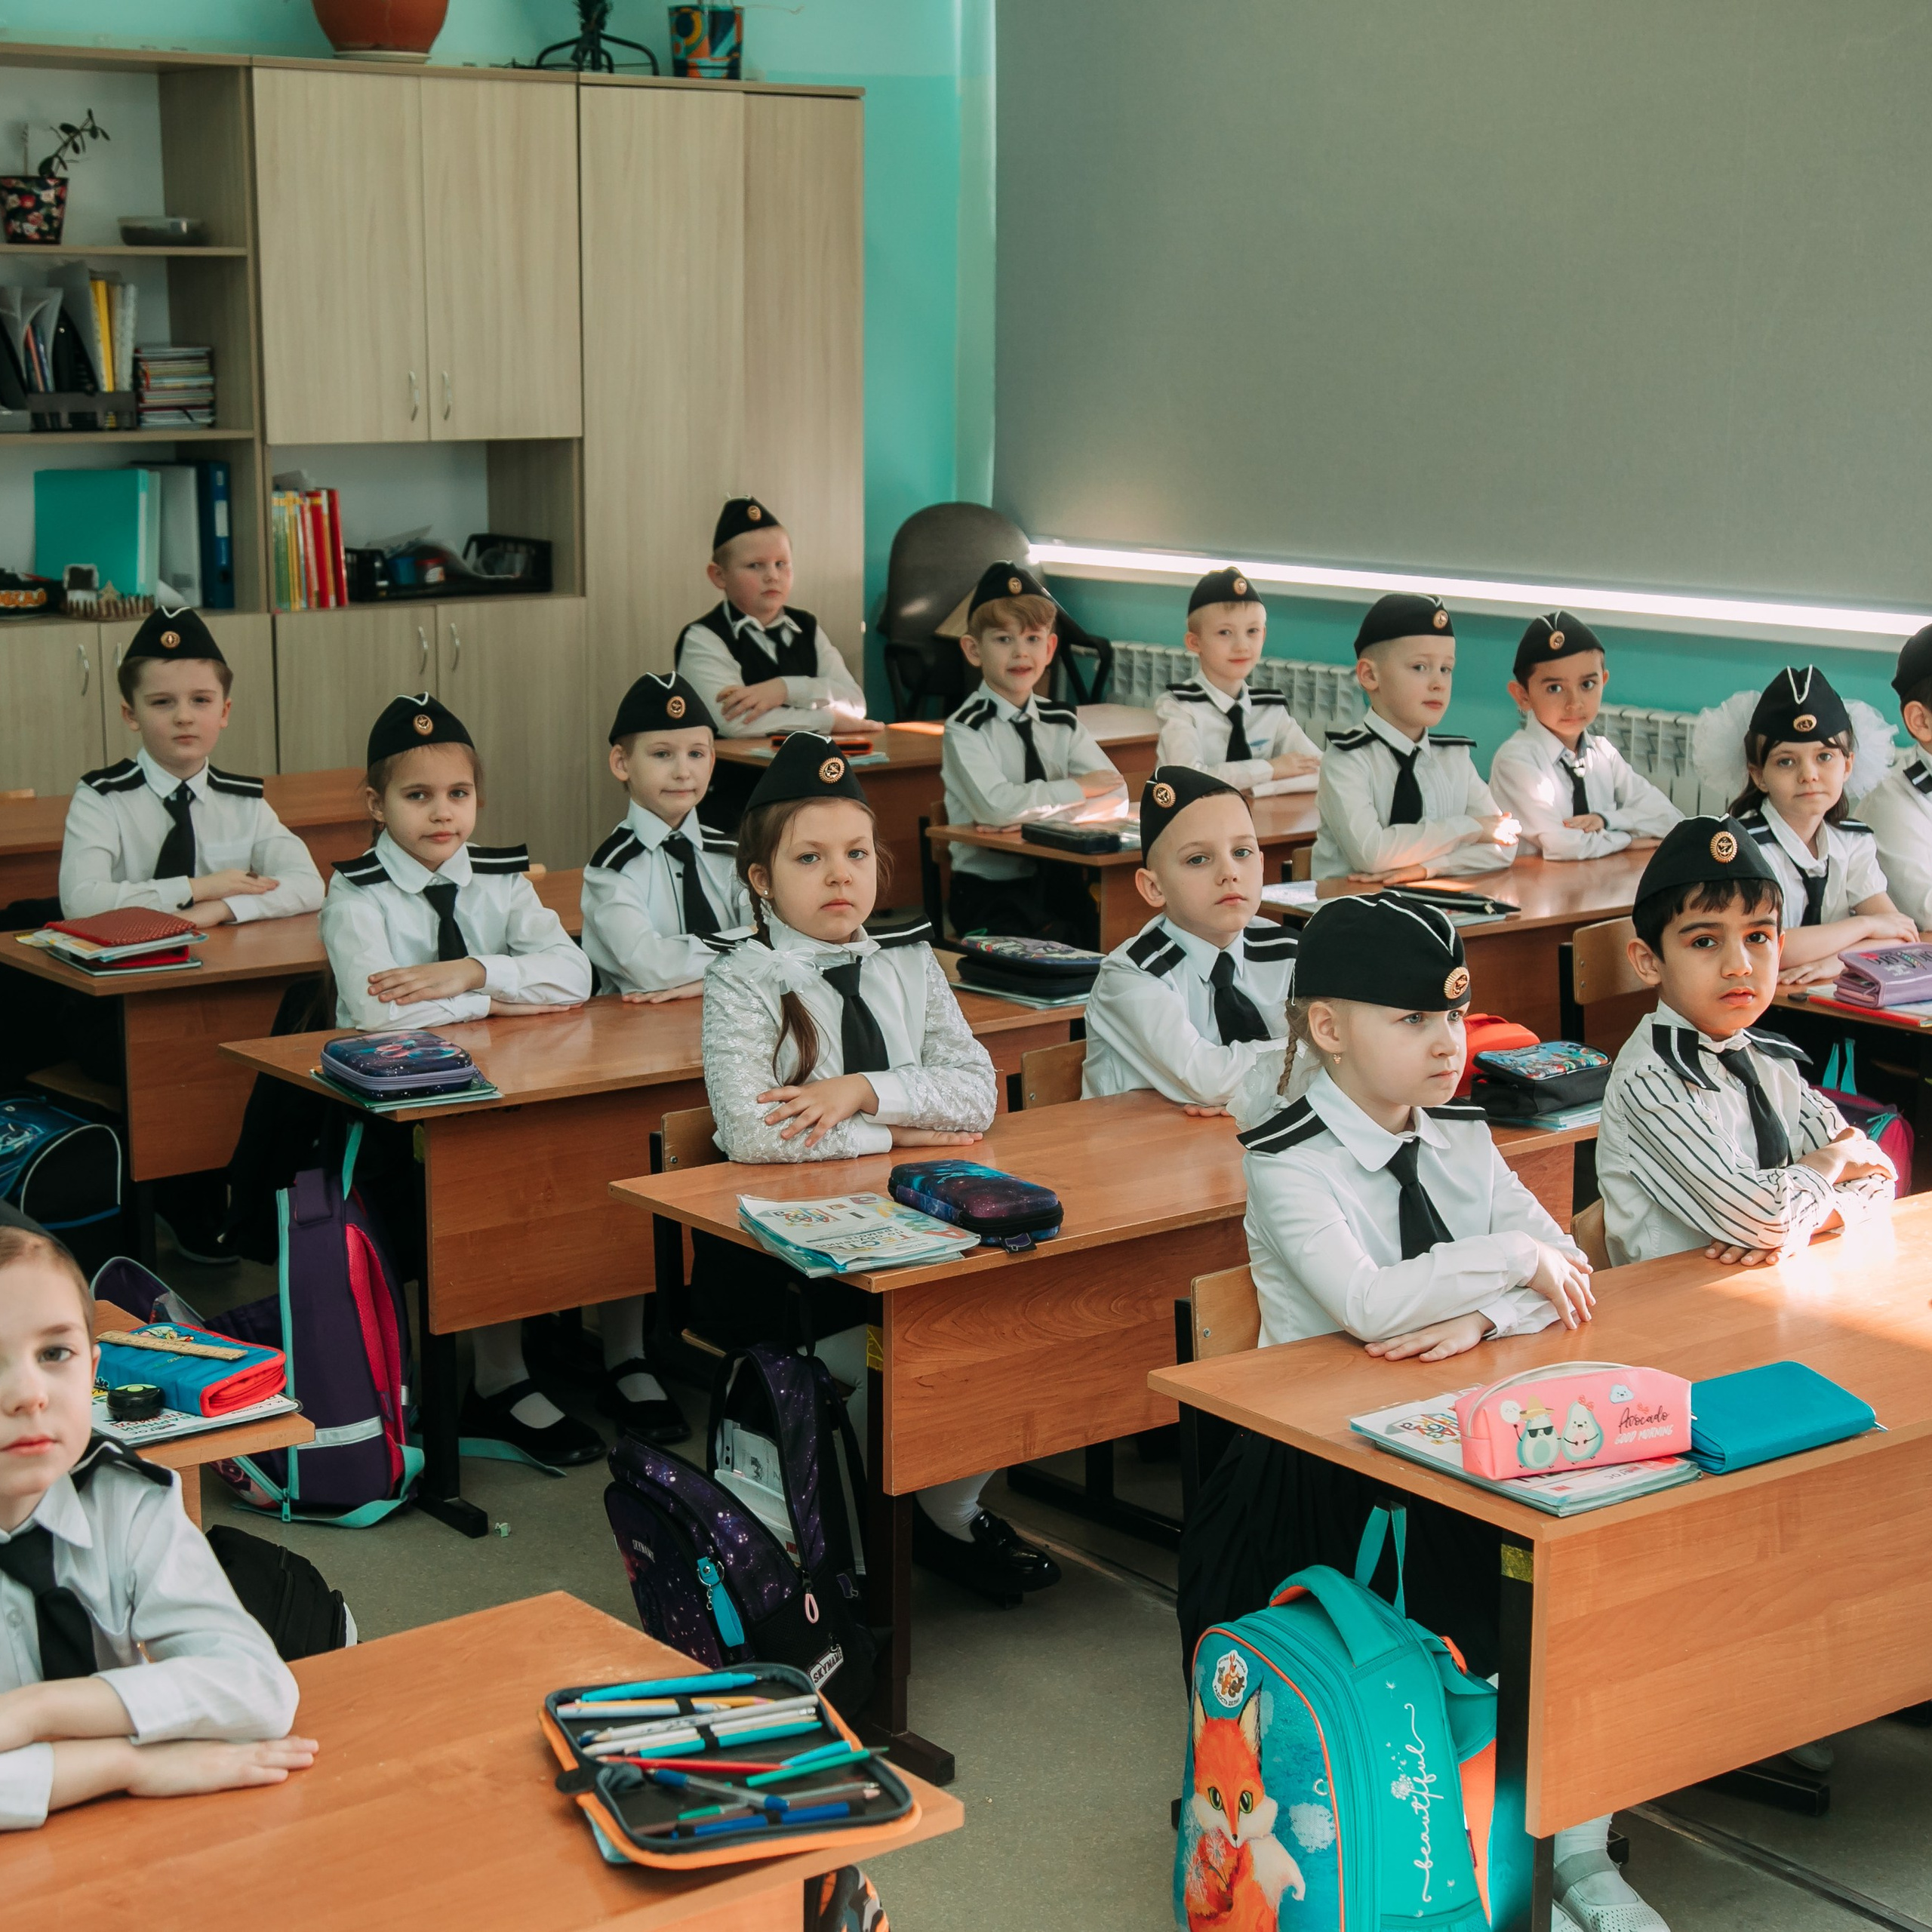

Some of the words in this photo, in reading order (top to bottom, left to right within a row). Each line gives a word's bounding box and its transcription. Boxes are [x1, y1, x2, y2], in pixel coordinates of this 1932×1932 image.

[816, 1235, 883, 1247] обучению
[844, 1228, 899, 1240] грамоте
[1618, 1405, 1670, 1434] Avocado
[1614, 1430, 1637, 1444] GOOD
[1638, 1424, 1674, 1441] MORNING
[632, 1539, 656, 1564] SKYNAME
[813, 1647, 843, 1684] SKYNAME
